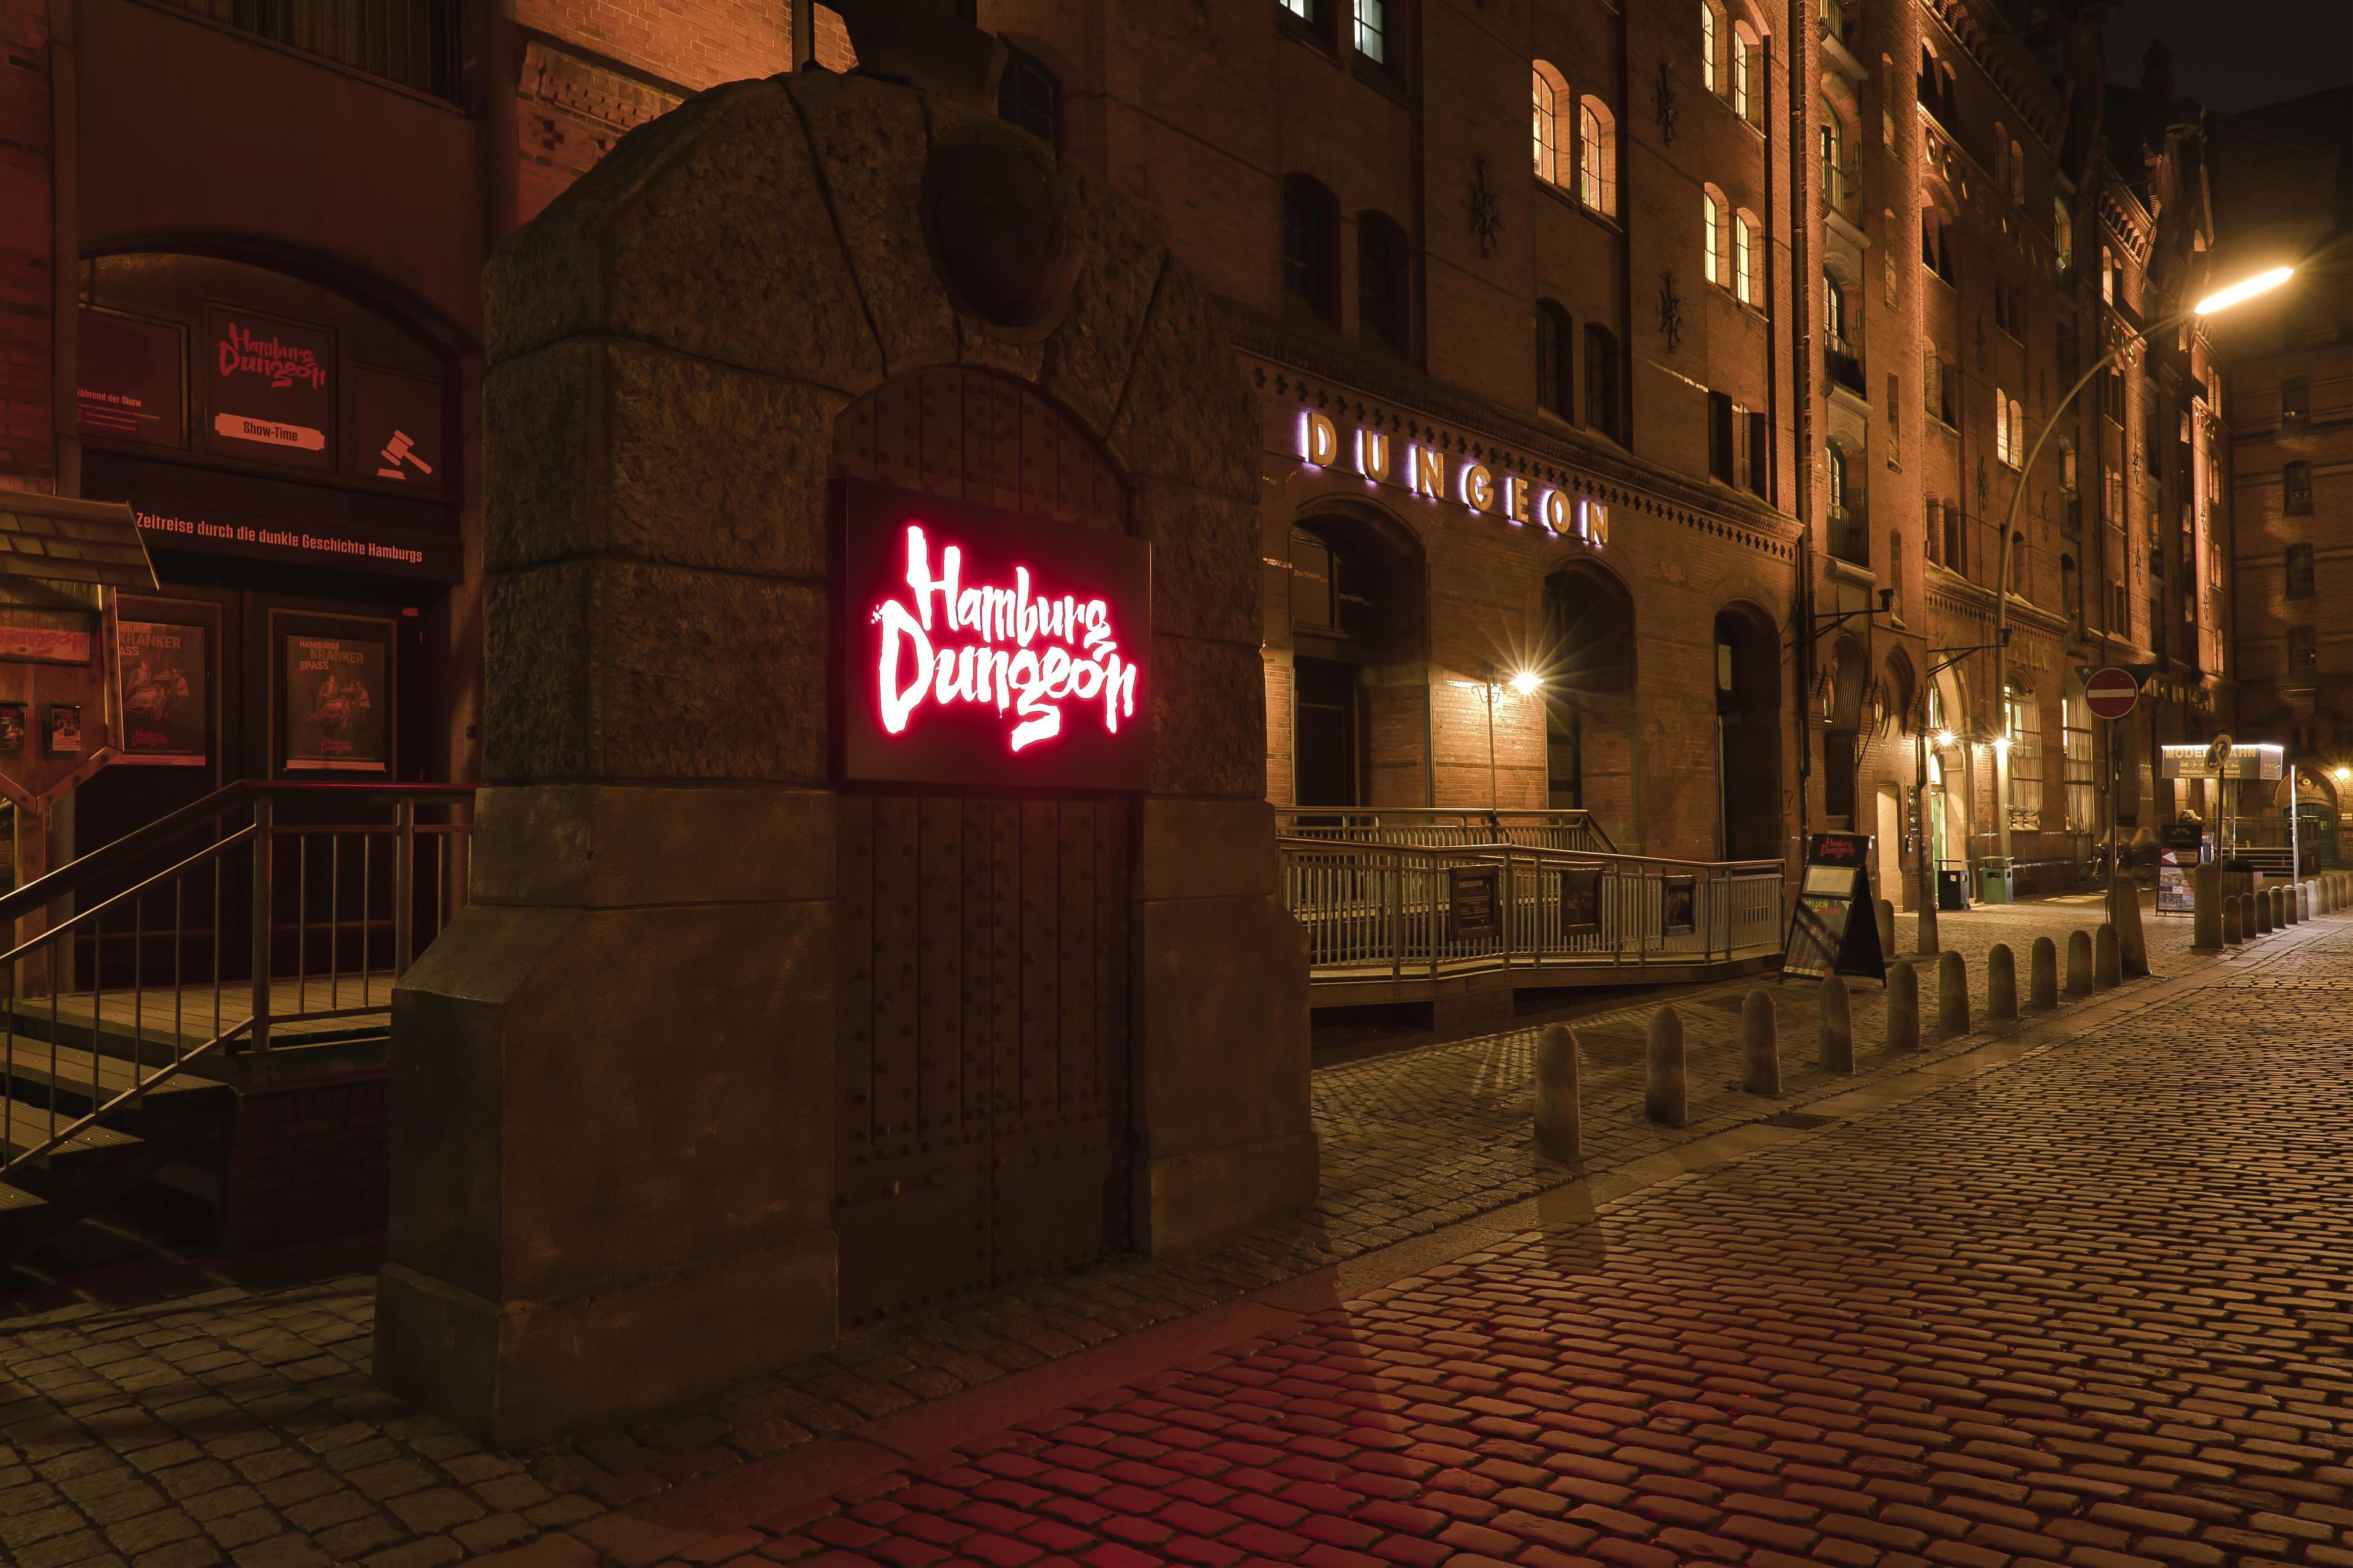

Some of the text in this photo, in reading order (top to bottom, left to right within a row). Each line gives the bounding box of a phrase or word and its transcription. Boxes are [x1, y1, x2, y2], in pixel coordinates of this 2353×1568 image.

[229, 322, 315, 364] Hamburg
[217, 340, 326, 390] Dungeon
[77, 388, 142, 407] ährend der Show
[243, 421, 298, 441] Show-Time
[1304, 411, 1608, 545] DUNGEON
[137, 512, 422, 563] Zeitreise durch die dunkle Geschichte Hamburgs
[906, 525, 1117, 661] Hamburg
[118, 624, 152, 634] MBURGS
[0, 631, 86, 656] ungeon
[119, 632, 181, 650] KRANKER
[299, 640, 340, 650] HAMBURGS
[119, 646, 140, 656] ASS
[309, 648, 364, 664] KRANKER
[299, 661, 330, 670] SPASS
[871, 599, 1137, 752] Dungeon
[2165, 747, 2257, 759] MODEAHN
[1825, 834, 1853, 849] Hamburg
[1820, 843, 1856, 859] Dungeon
